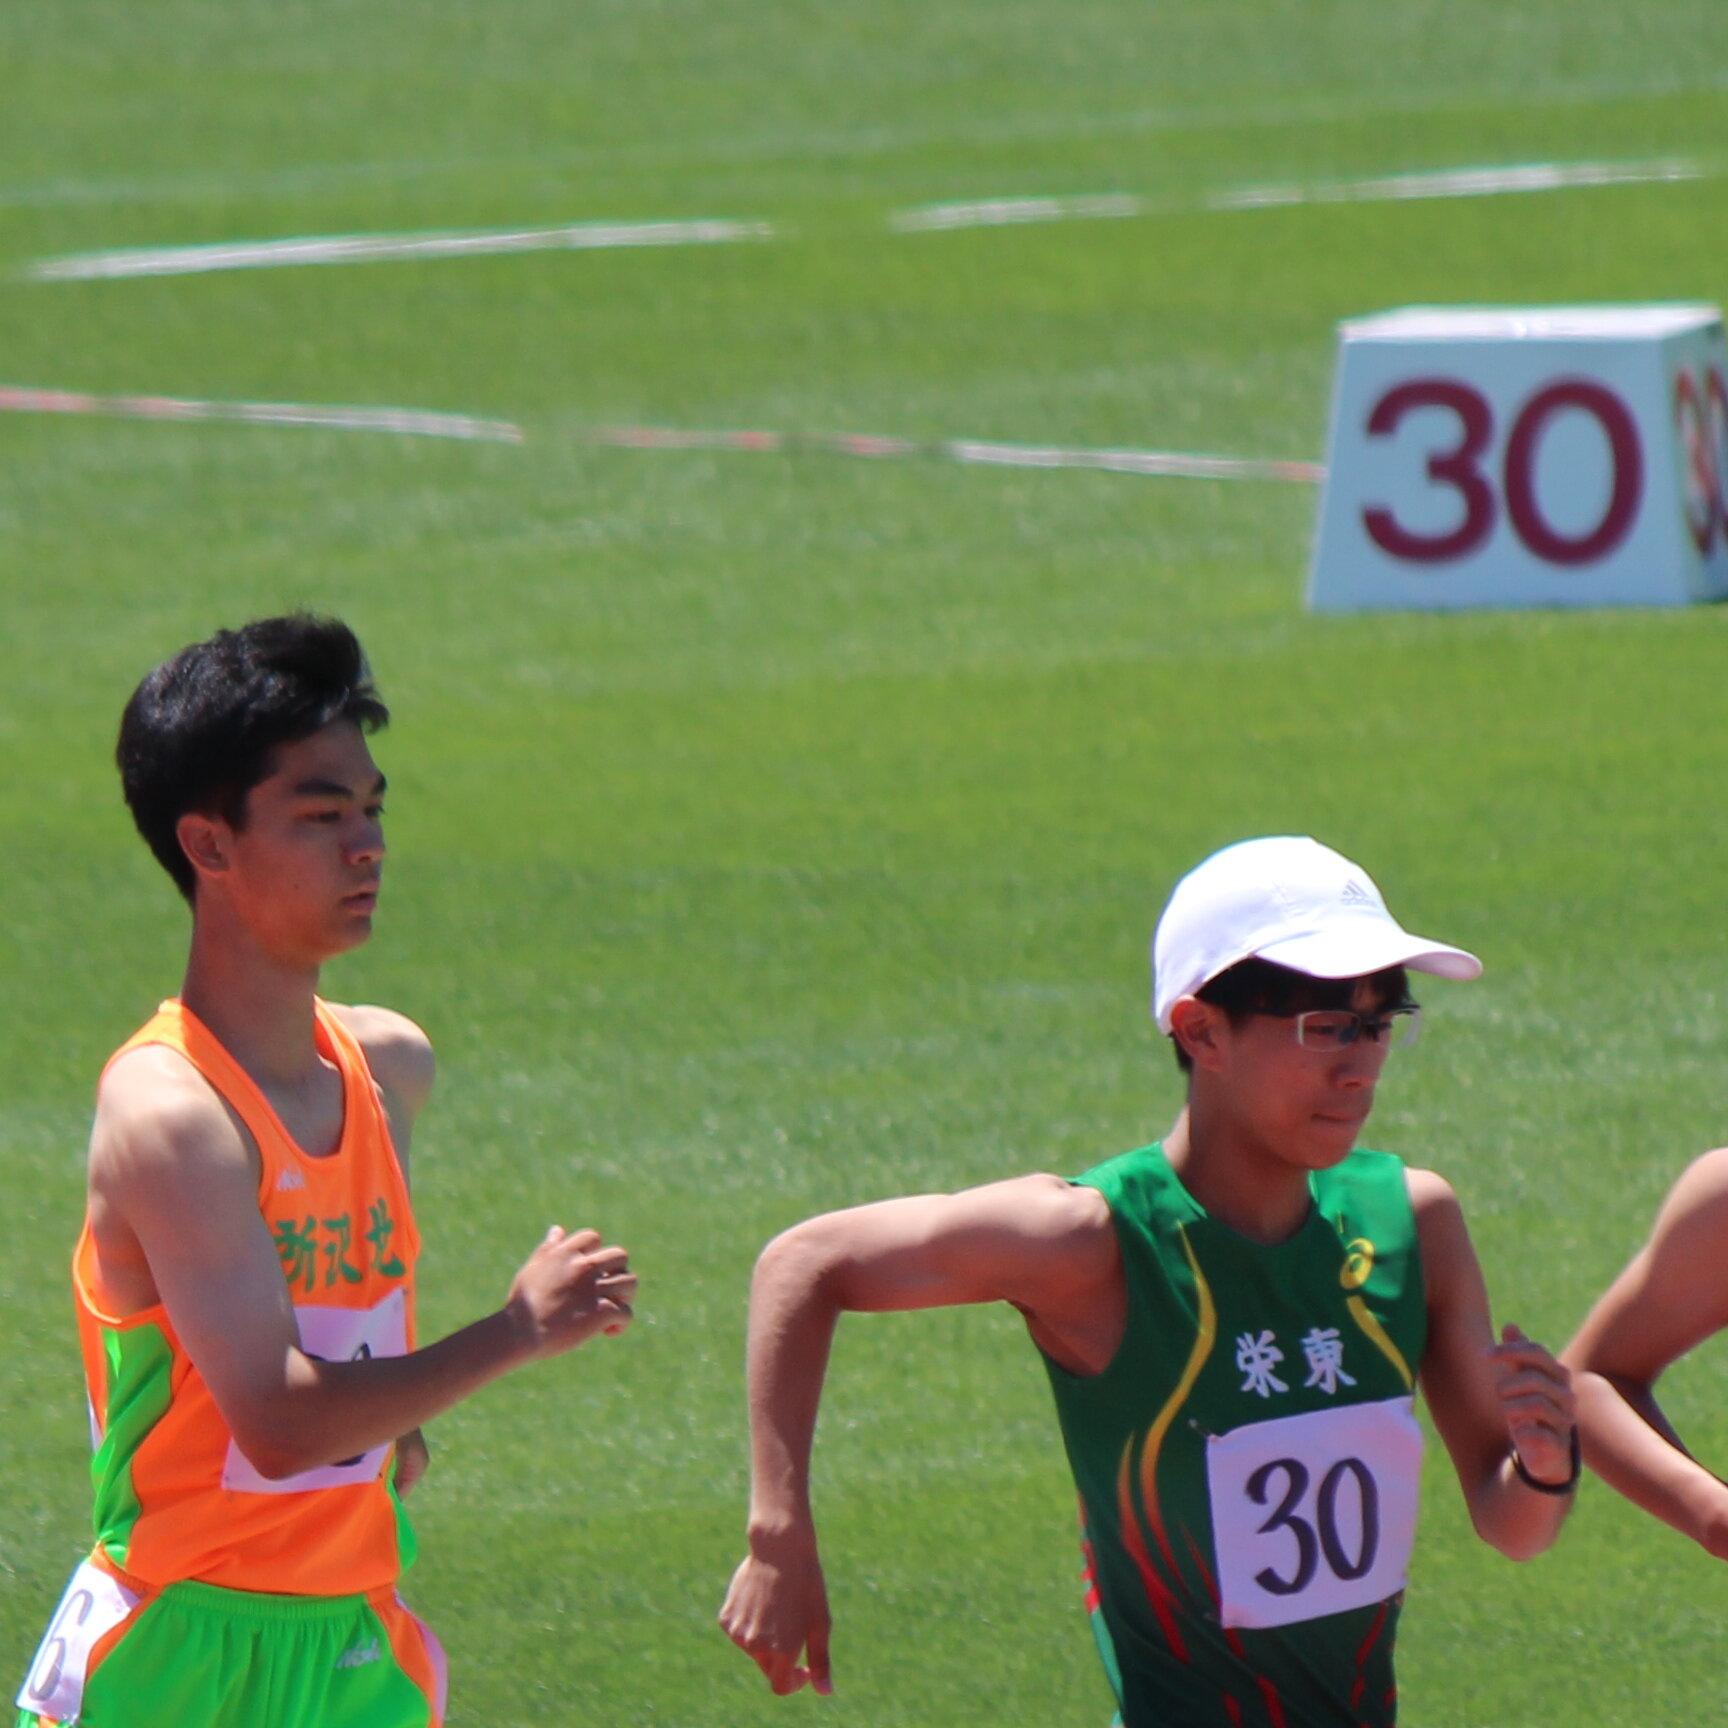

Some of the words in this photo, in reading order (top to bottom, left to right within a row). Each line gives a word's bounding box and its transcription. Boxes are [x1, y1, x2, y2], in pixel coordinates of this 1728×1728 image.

[1362, 372, 1645, 570] 30
[1236, 1327, 1358, 1399] 栄東
[1245, 1457, 1380, 1596] 30
